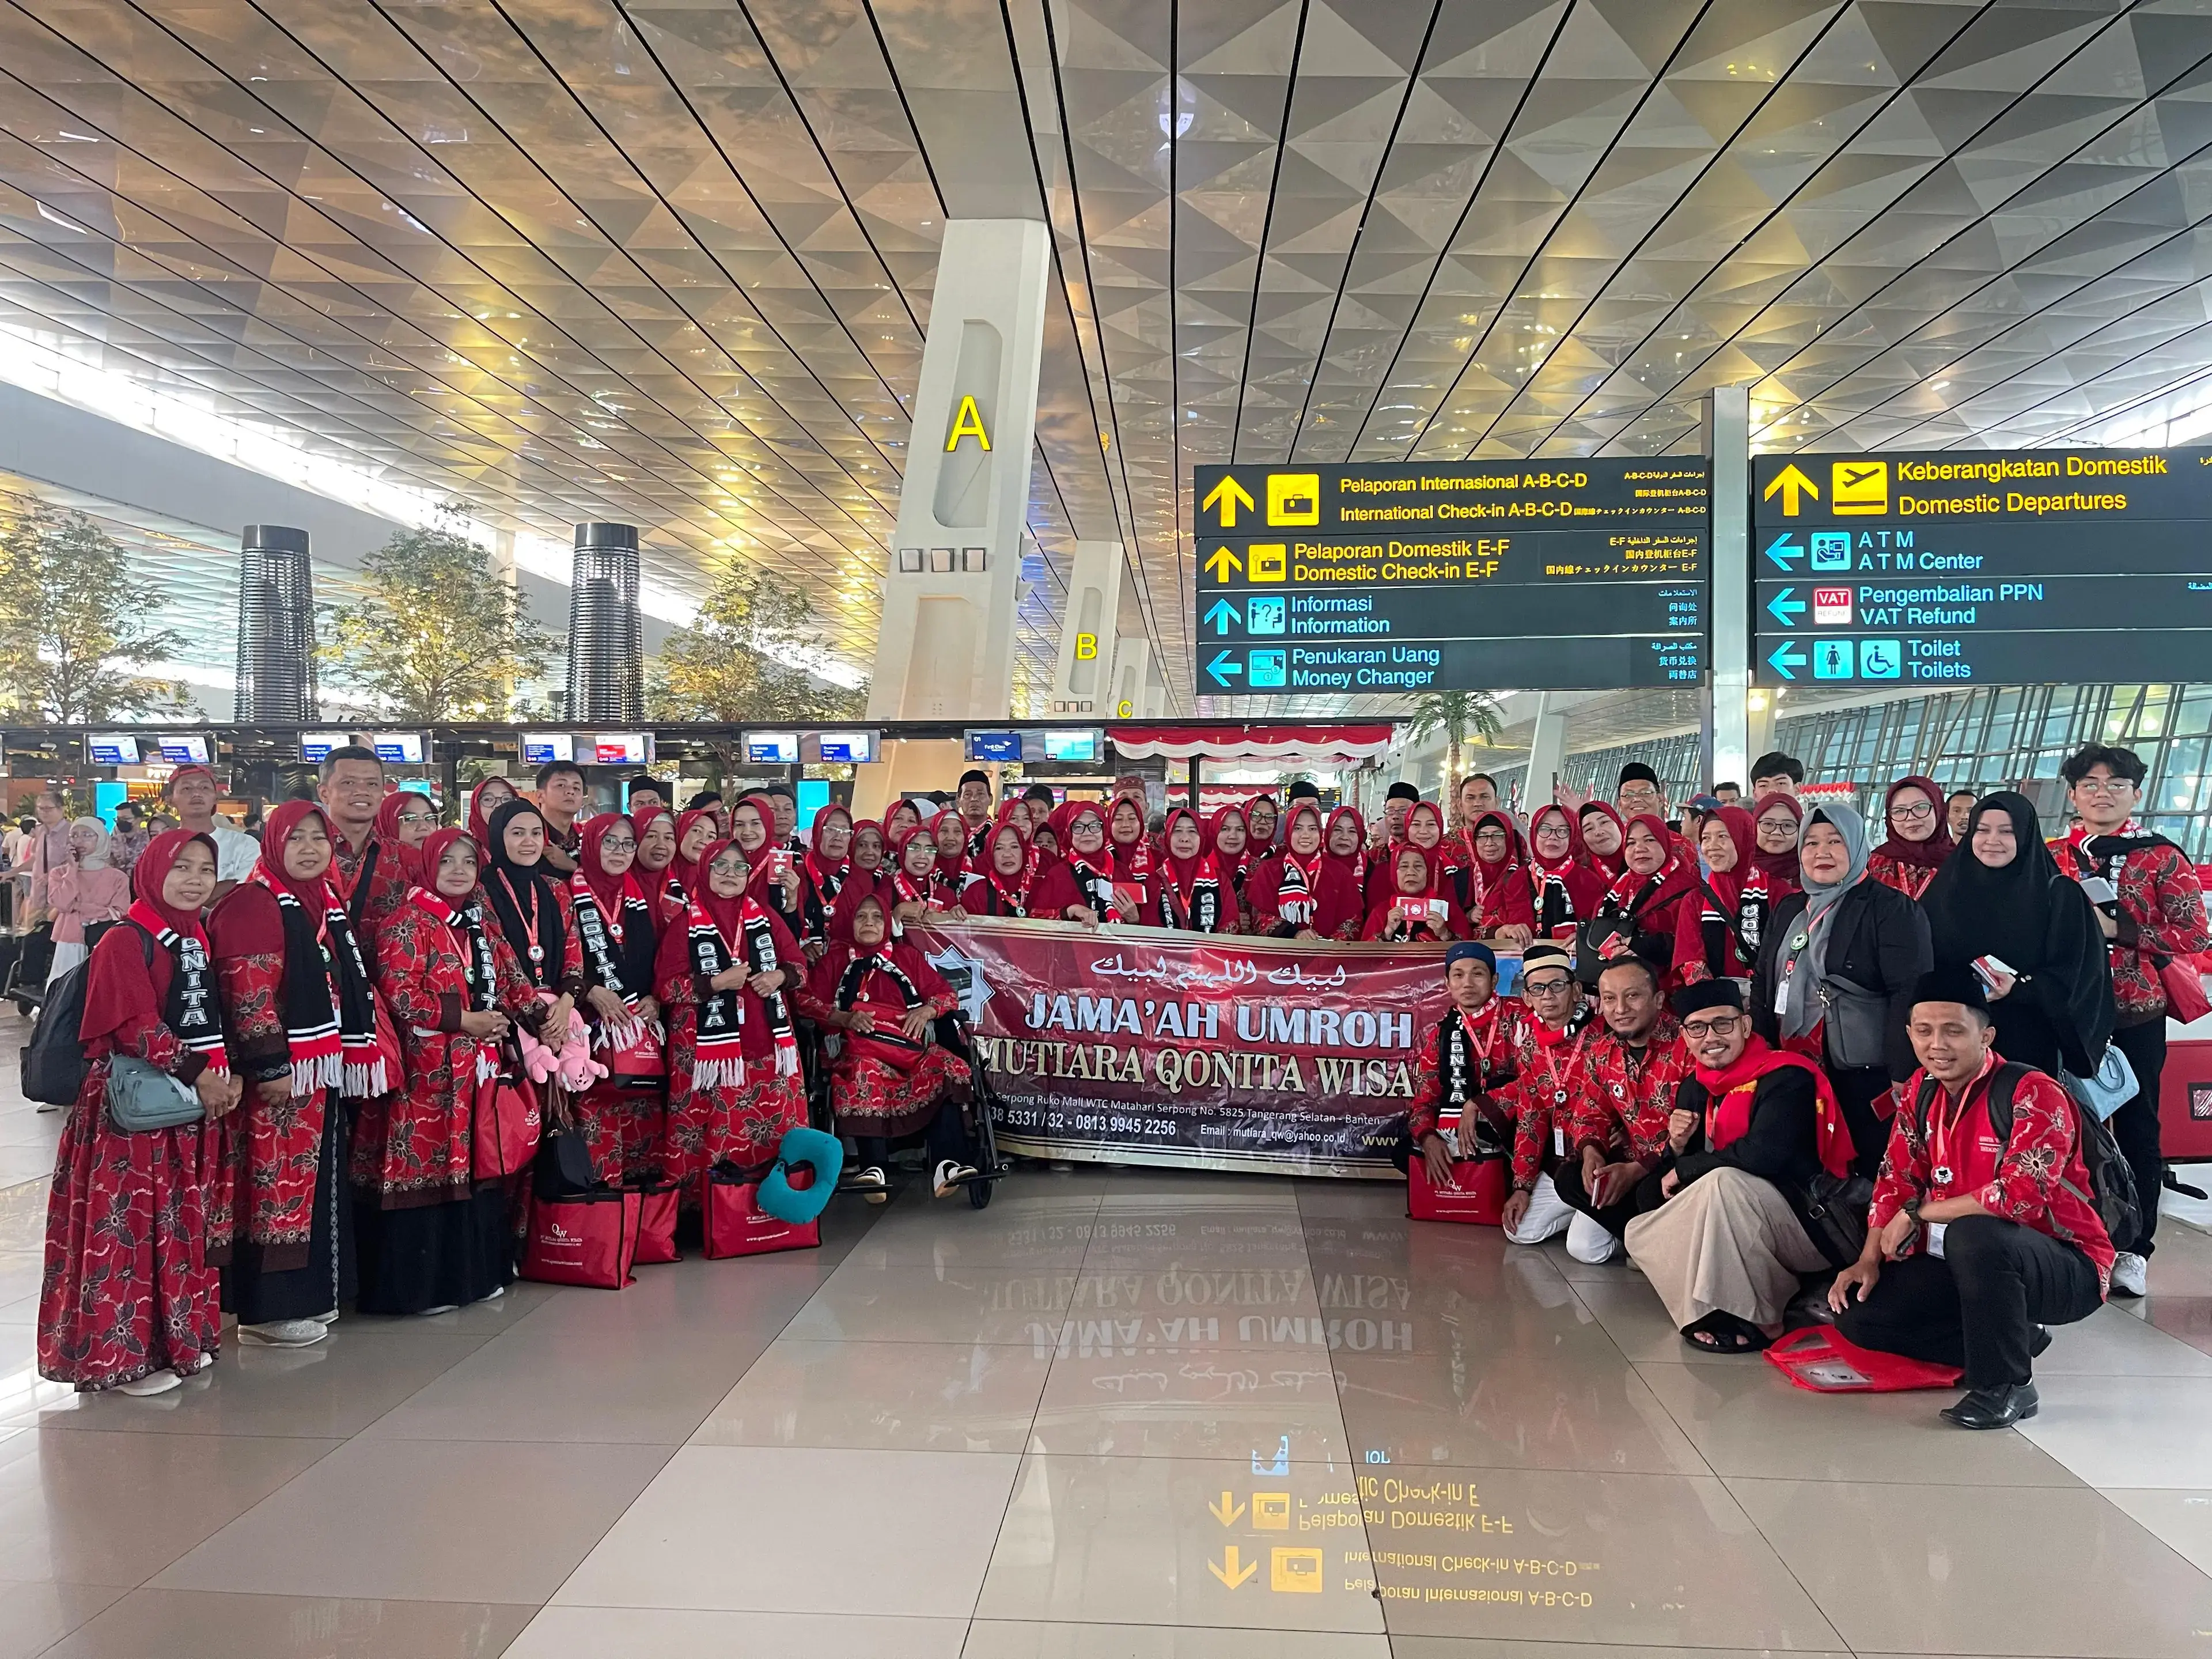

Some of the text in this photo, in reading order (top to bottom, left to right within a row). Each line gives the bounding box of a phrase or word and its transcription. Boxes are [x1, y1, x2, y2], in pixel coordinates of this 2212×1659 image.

[946, 396, 992, 452] A
[1899, 455, 2167, 483] Keberangkatan Domestik
[1341, 474, 1587, 495] Pelaporan Internasional A-B-C-D
[1342, 502, 1572, 521] International Check-in A-B-C-D
[1677, 506, 1707, 514] A-B-C-D
[1900, 492, 2126, 515] Domestic Departures
[1294, 539, 1510, 563] Pelaporan Domestik E-F
[1609, 536, 1626, 546] E-F
[1681, 563, 1698, 571] E-F
[1919, 552, 1983, 569] Center
[1294, 561, 1498, 581] Domestic Check-in E-F
[1292, 595, 1372, 612] Informasi
[1819, 592, 1847, 604] VAT
[1860, 584, 2043, 608] Pengembalian PPN
[1292, 617, 1389, 633] Information
[1860, 607, 1975, 625] VAT Refund
[1077, 633, 1097, 660] B
[1293, 647, 1440, 666] Penukaran Uang
[1908, 639, 1961, 656] Toilet
[1293, 669, 1434, 689] Money Changer
[1908, 661, 1971, 678] Toilets
[1118, 700, 1132, 718] C
[579, 908, 624, 991] QONITA
[1090, 953, 1166, 982] لبيك
[1267, 963, 1346, 991] لبيك
[698, 942, 726, 1028] QOTA
[1236, 1005, 1412, 1048] UMROH
[975, 1035, 1419, 1098] MUTIARA QONITA WISA
[996, 1092, 1035, 1105] Serpong
[1037, 1095, 1060, 1105] Ruko
[1062, 1097, 1084, 1107] Mall
[1086, 1099, 1109, 1109] WTC
[1111, 1100, 1154, 1112] Matahari
[1157, 1104, 1197, 1117] Serpong
[1200, 1107, 1217, 1116] No.
[1247, 1109, 1297, 1123] Tangerang
[1300, 1112, 1336, 1123] Selatan
[1345, 1115, 1380, 1125] Banten
[987, 1105, 1004, 1122] 38
[1007, 1109, 1037, 1126] 5331
[1048, 1112, 1064, 1128] 32
[1075, 1115, 1107, 1131] 0813
[1109, 1116, 1142, 1134] 9945
[1144, 1119, 1176, 1136] 2256
[1200, 1124, 1226, 1136] Email
[1233, 1126, 1346, 1144] mutiara_qw@yahoo.co.id
